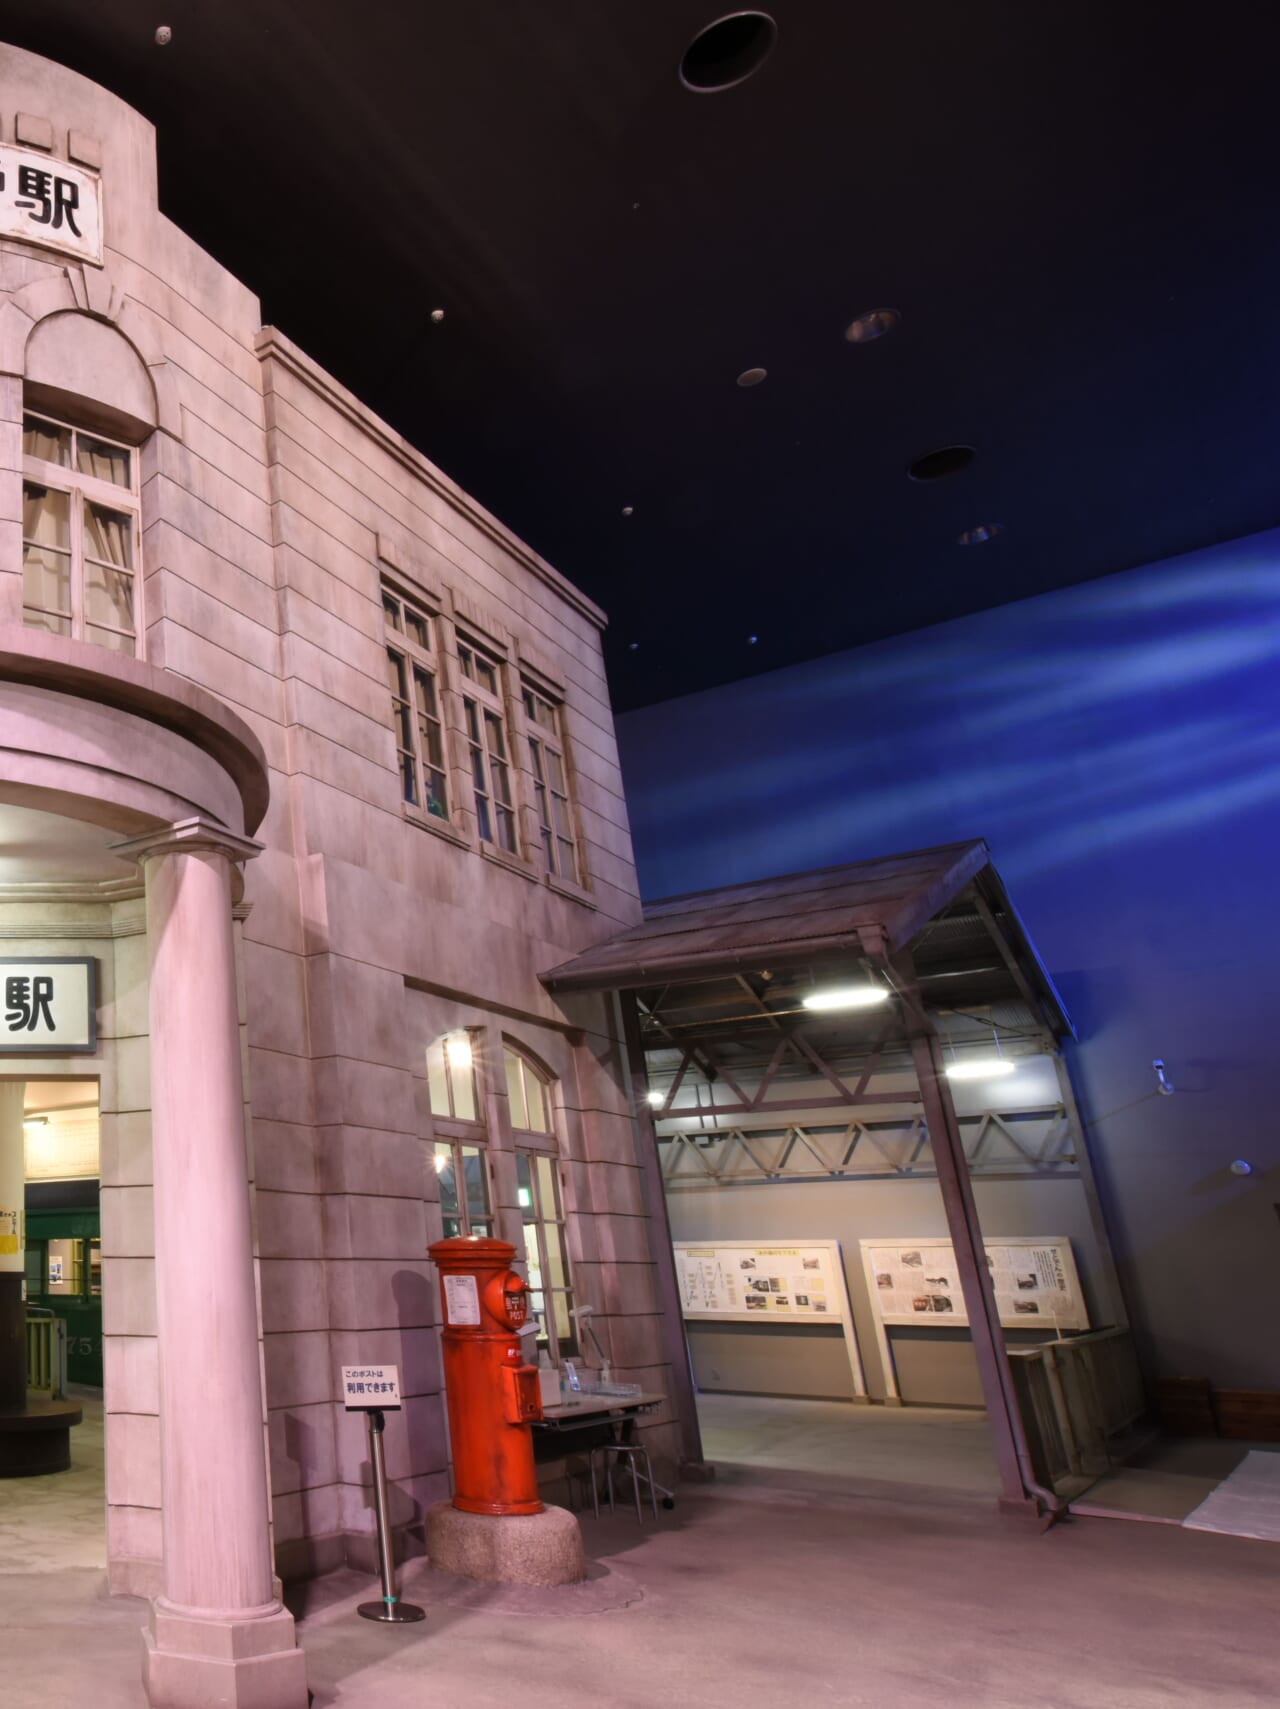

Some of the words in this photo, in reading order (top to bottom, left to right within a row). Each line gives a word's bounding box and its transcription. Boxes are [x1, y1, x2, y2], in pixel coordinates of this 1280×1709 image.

[509, 1310, 524, 1321] POST
[345, 1370, 384, 1378] このポストは
[347, 1382, 396, 1394] 利用できます
